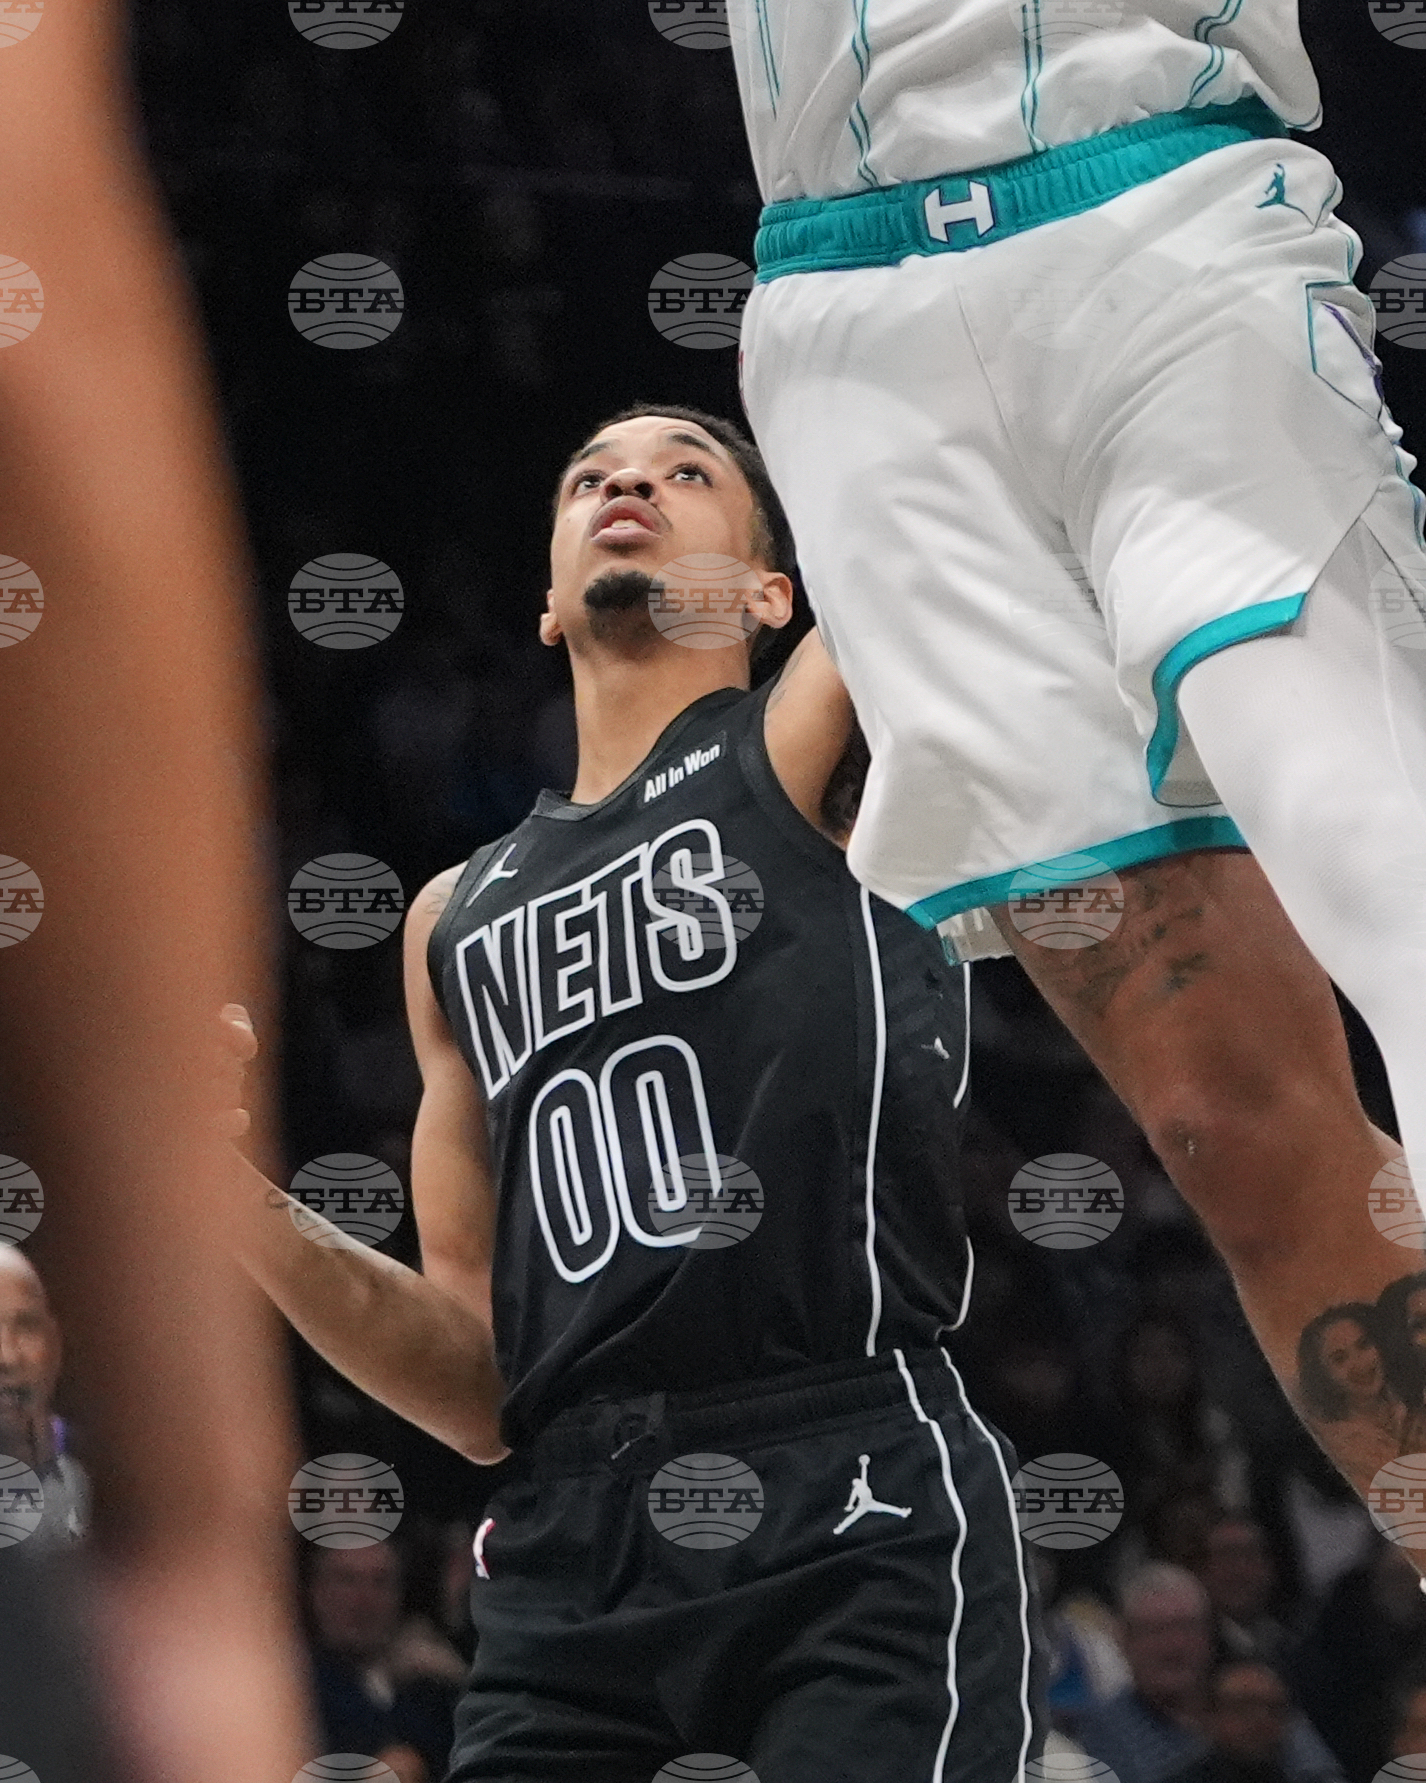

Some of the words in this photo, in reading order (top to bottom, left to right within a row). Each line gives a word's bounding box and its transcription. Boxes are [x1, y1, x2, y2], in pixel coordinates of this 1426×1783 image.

[643, 772, 667, 804] All
[668, 766, 685, 788] In
[683, 744, 721, 776] Won
[456, 818, 738, 1100] NETS
[528, 1034, 723, 1284] 00
